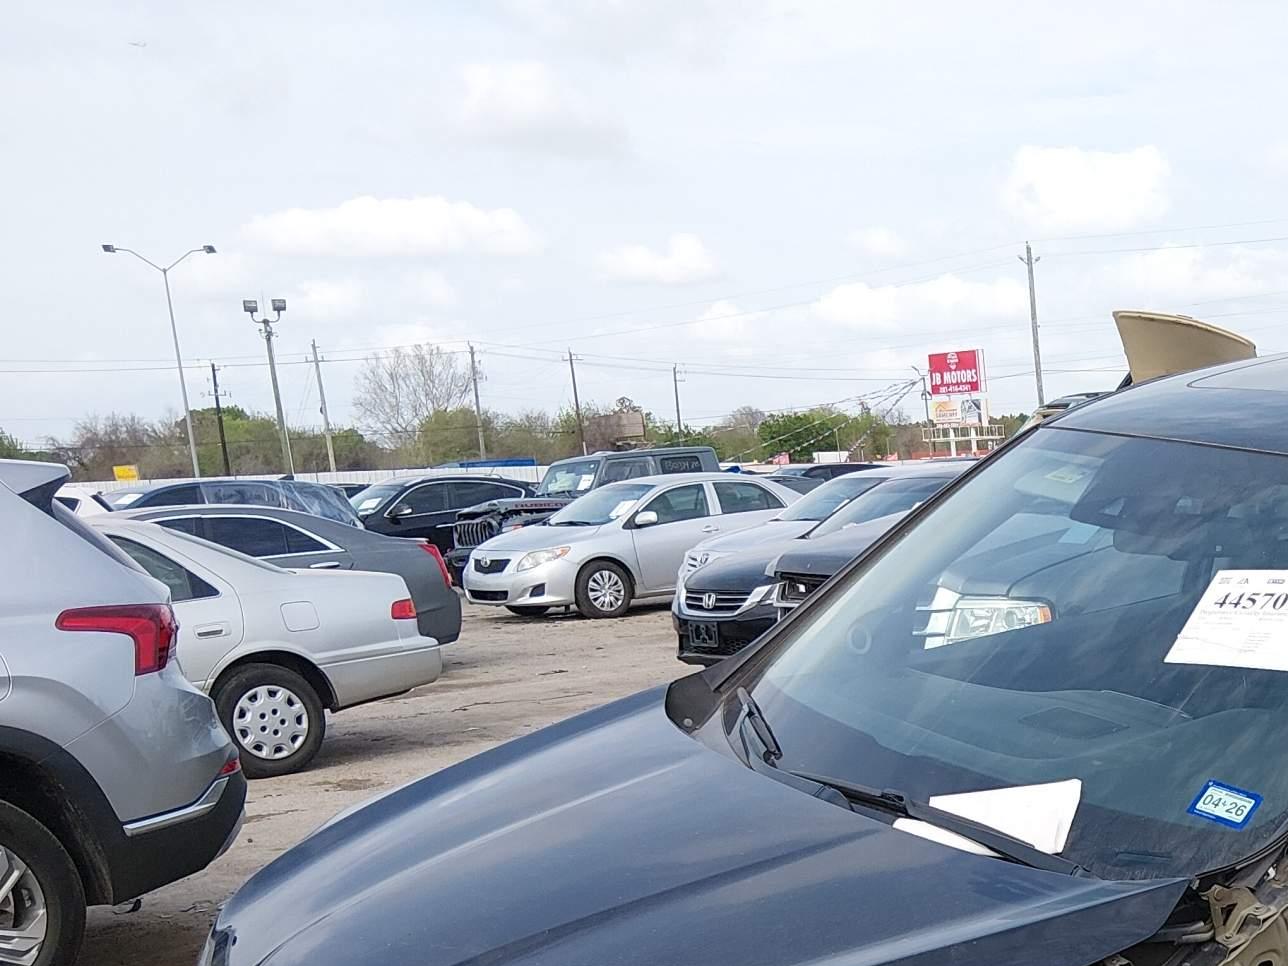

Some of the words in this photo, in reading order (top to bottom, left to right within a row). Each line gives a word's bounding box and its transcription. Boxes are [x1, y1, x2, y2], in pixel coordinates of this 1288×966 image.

[932, 372, 942, 385] JB
[943, 369, 977, 385] MOTORS
[1202, 794, 1220, 809] 04
[1224, 801, 1247, 817] 26
